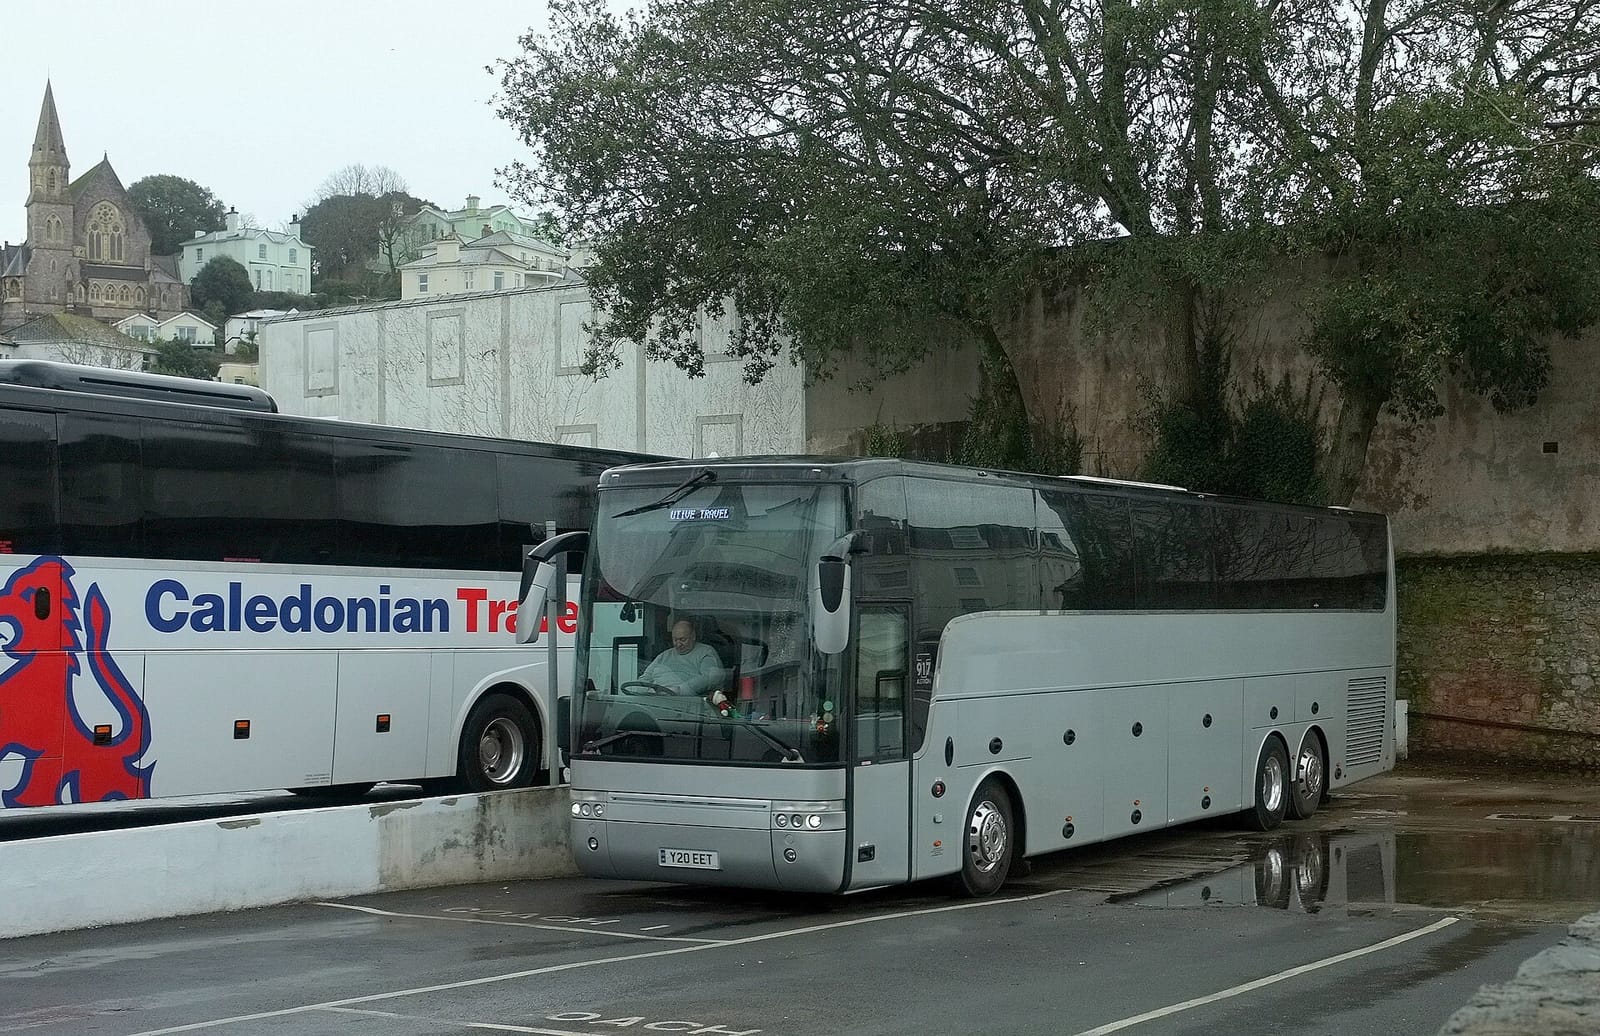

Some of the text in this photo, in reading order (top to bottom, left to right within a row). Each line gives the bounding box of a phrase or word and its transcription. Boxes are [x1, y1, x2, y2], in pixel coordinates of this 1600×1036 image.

[699, 508, 729, 519] TRAVEL
[144, 578, 579, 634] Caledonian Tre
[670, 851, 713, 866] Y20 EET
